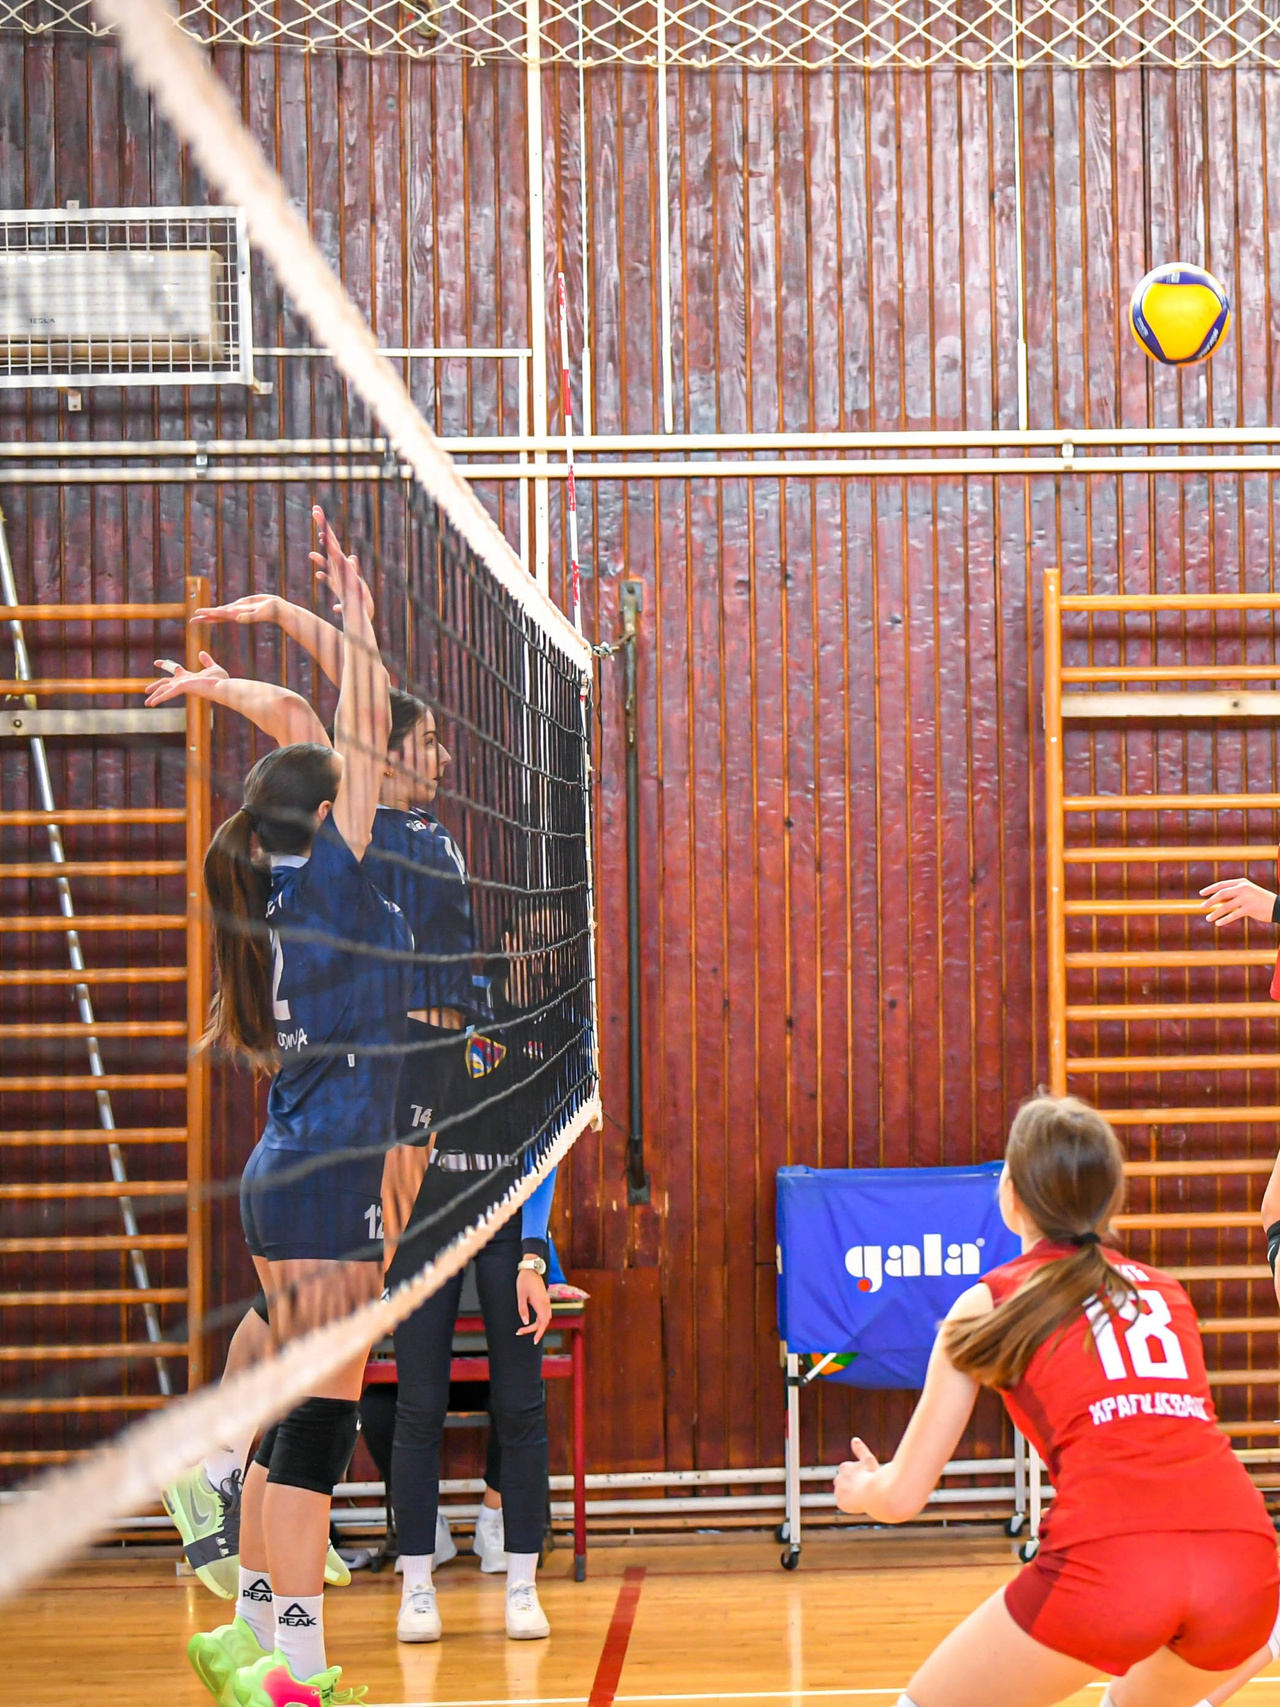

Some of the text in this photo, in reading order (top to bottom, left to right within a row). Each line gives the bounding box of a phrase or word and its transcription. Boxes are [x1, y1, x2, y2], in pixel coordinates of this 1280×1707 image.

[844, 1233, 981, 1293] gala
[1082, 1289, 1189, 1381] 18
[243, 1590, 273, 1602] PEA
[278, 1617, 317, 1627] PEAK
